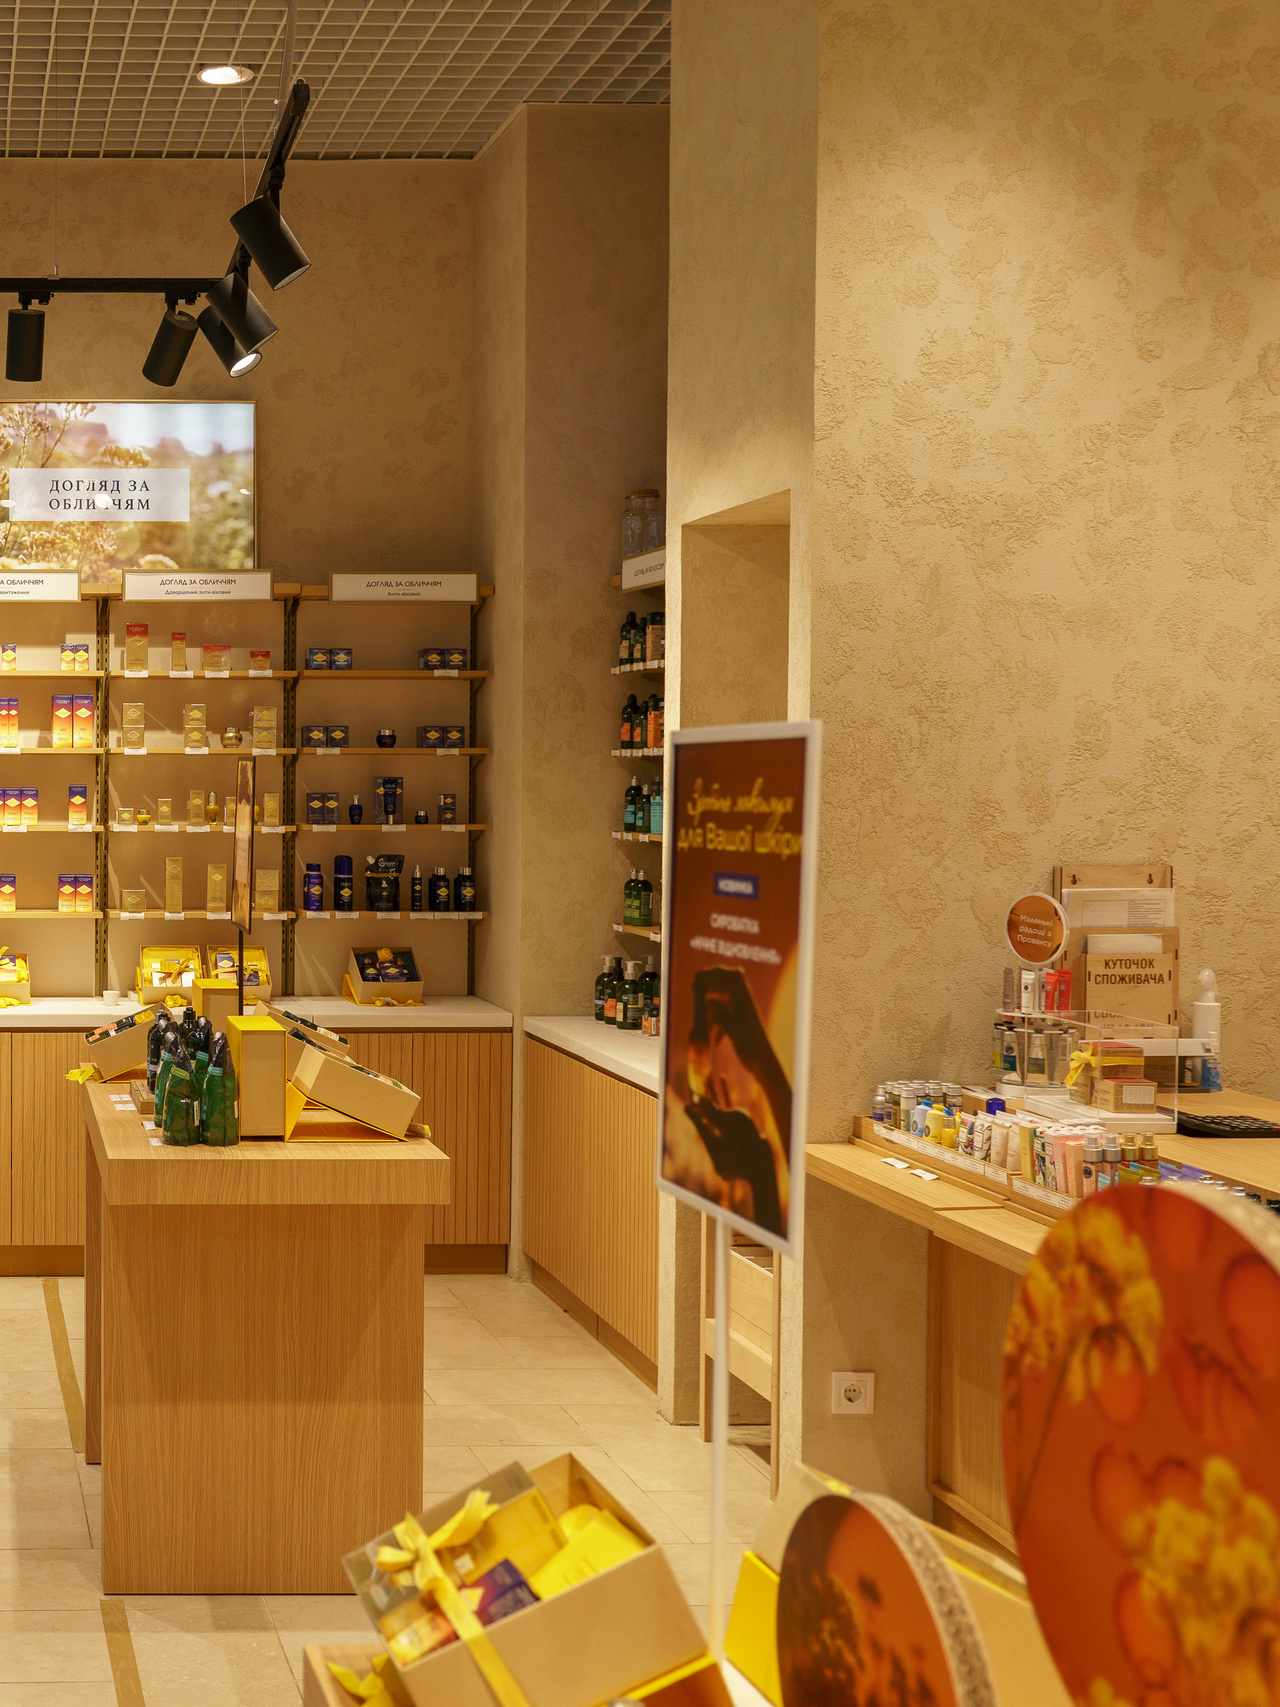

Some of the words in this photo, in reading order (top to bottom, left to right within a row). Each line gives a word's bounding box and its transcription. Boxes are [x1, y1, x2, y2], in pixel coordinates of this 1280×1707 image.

[49, 479, 121, 494] ДОГЛЯД
[128, 480, 151, 492] ЗА
[48, 498, 151, 511] ОБЛИЧЯМ
[705, 821, 753, 851] Вашої
[1020, 914, 1053, 927] Маленькі
[1020, 926, 1046, 937] радощі
[1017, 934, 1052, 948] Провансу
[1104, 958, 1155, 970] КУТОЧОК
[1094, 973, 1165, 985] СПОЖИВАЧА
